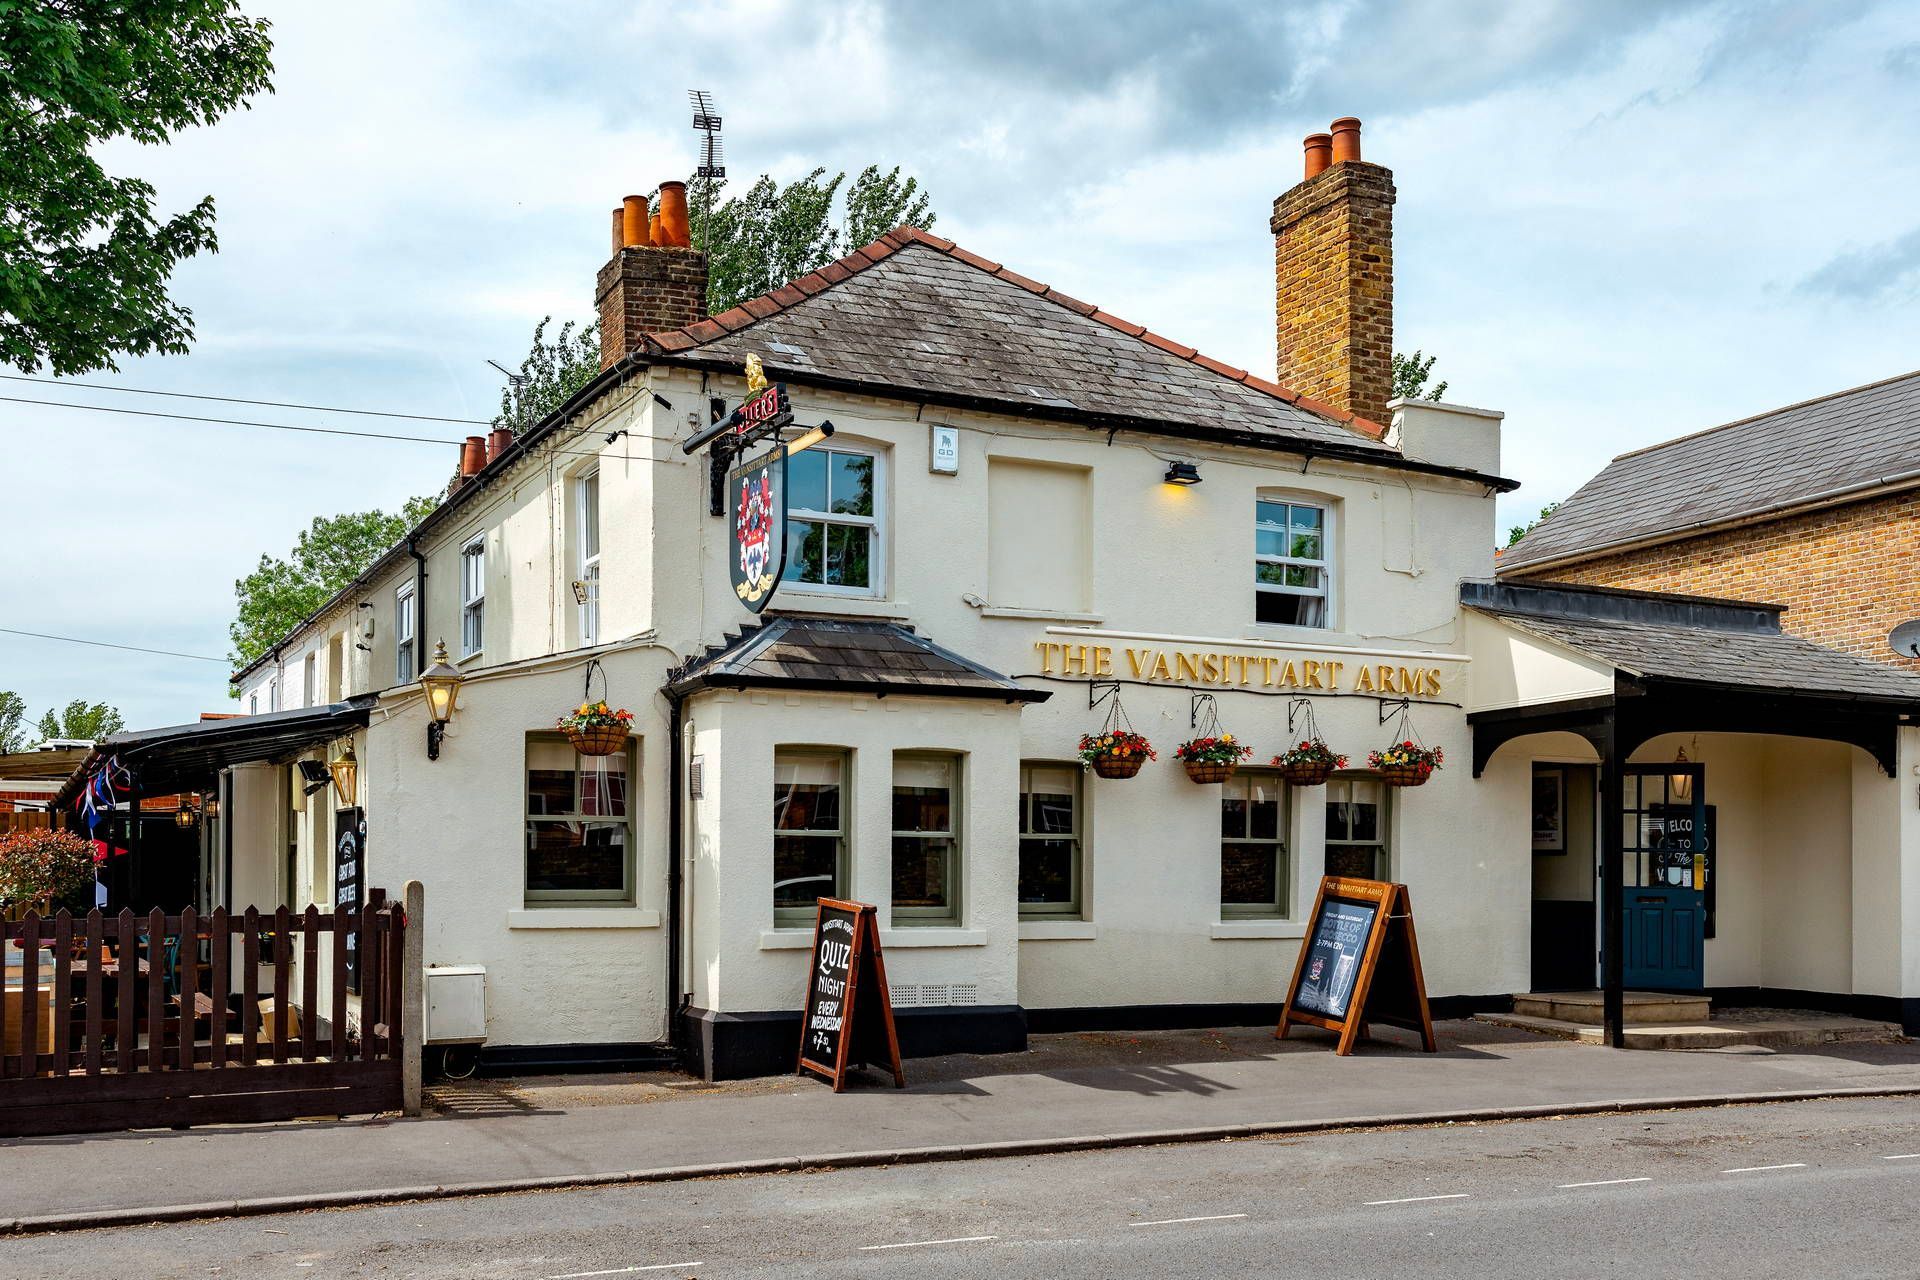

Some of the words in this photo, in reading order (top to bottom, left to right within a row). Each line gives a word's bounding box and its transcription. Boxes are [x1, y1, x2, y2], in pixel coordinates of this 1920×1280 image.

[731, 469, 741, 480] THE
[1035, 641, 1114, 677] THE
[1126, 648, 1344, 689] VANSITTART
[1354, 664, 1442, 697] ARMS
[1677, 839, 1691, 849] TO
[1674, 852, 1692, 865] The
[1326, 882, 1336, 890] THE
[1336, 883, 1368, 894] VANSITTART
[1367, 887, 1383, 897] ARMS
[1322, 917, 1350, 931] BOTTLE
[1349, 921, 1362, 933] OF
[1319, 928, 1358, 944] PROSECCO
[819, 939, 851, 975] QUIZ
[818, 975, 845, 998] NIGHT
[817, 1000, 839, 1016] EVERY
[810, 1014, 843, 1032] WEDNESDAY
